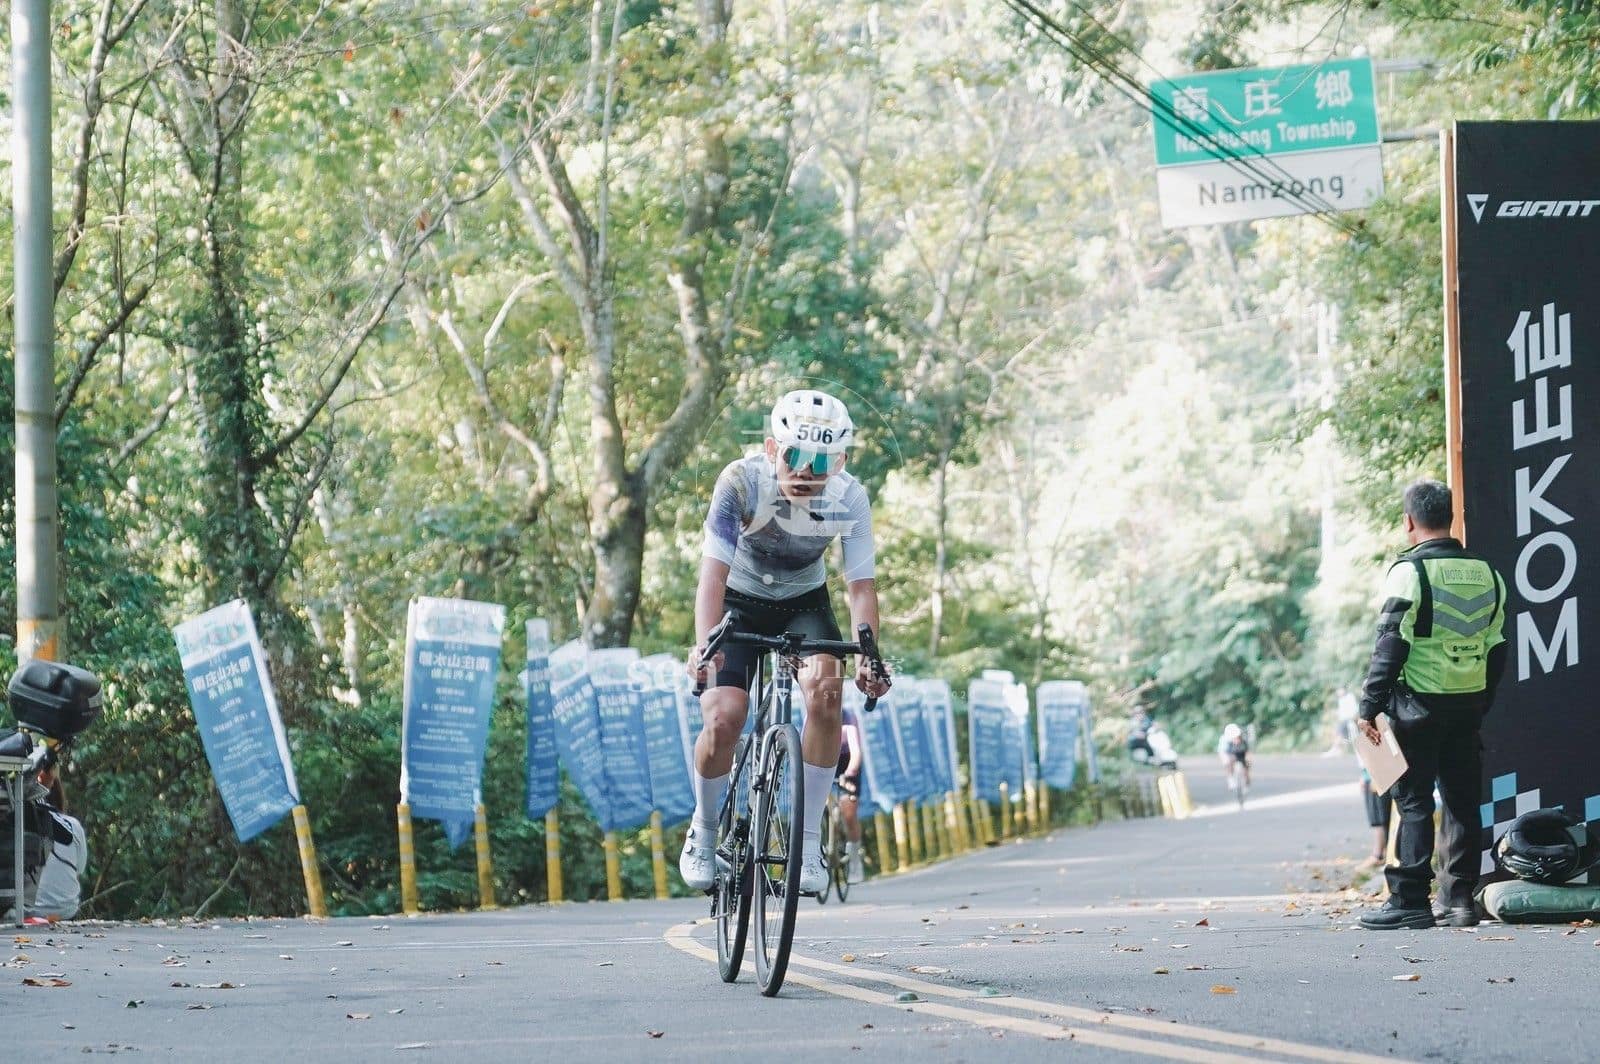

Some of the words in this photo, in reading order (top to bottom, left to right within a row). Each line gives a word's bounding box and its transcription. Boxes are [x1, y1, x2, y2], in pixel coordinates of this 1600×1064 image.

[1277, 117, 1357, 142] Township
[1199, 175, 1345, 206] Namzong
[1496, 200, 1600, 217] GIANT
[796, 423, 834, 446] 506
